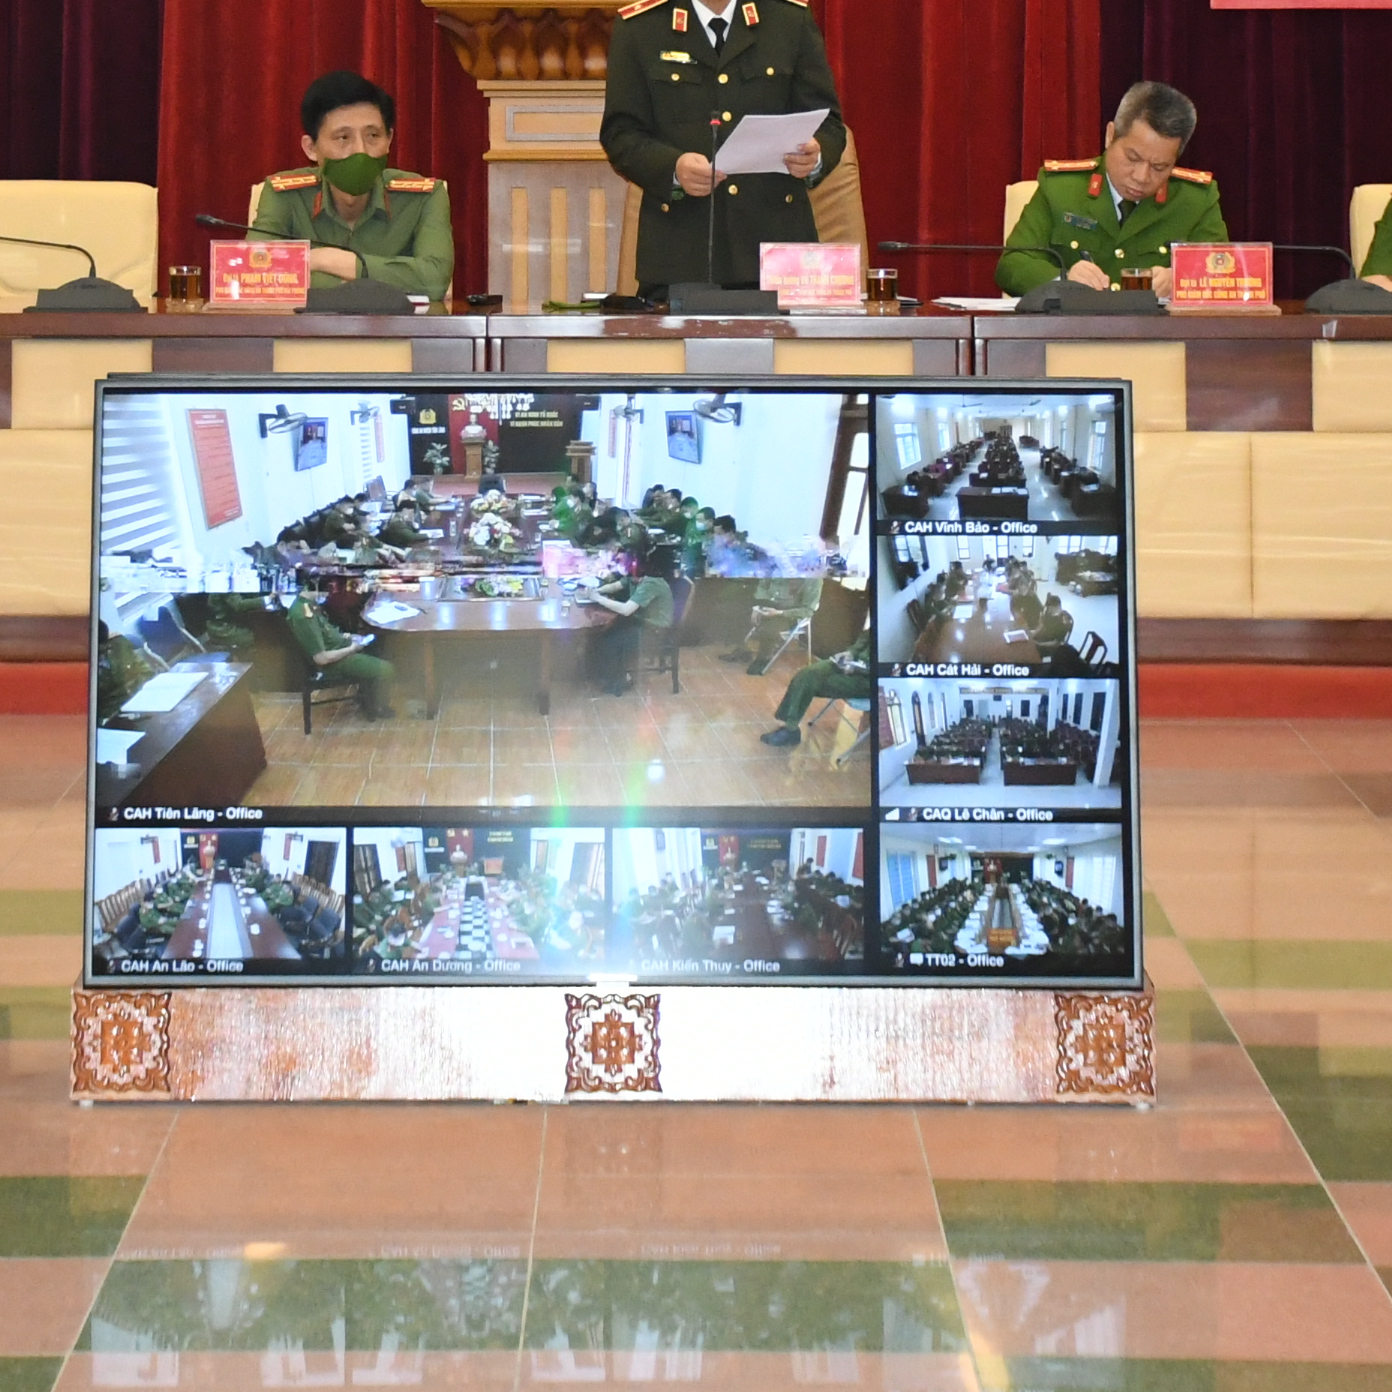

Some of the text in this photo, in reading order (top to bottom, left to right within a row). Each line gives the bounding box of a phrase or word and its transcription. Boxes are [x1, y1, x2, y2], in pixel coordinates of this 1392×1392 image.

[904, 521, 932, 534] CAH
[965, 521, 990, 534] Bảo
[1000, 521, 1038, 534] Office
[906, 663, 934, 676] CAH
[992, 663, 1030, 676] Office
[123, 807, 152, 820] CAH
[225, 807, 263, 820] Office
[923, 808, 951, 821] CAQ
[1016, 808, 1053, 821] Office
[121, 960, 149, 973] CAH
[152, 960, 169, 973] An
[207, 960, 244, 973] Office
[381, 959, 409, 972] CAH
[484, 959, 521, 972] Office
[743, 959, 781, 972] Office
[967, 953, 1004, 967] Office
